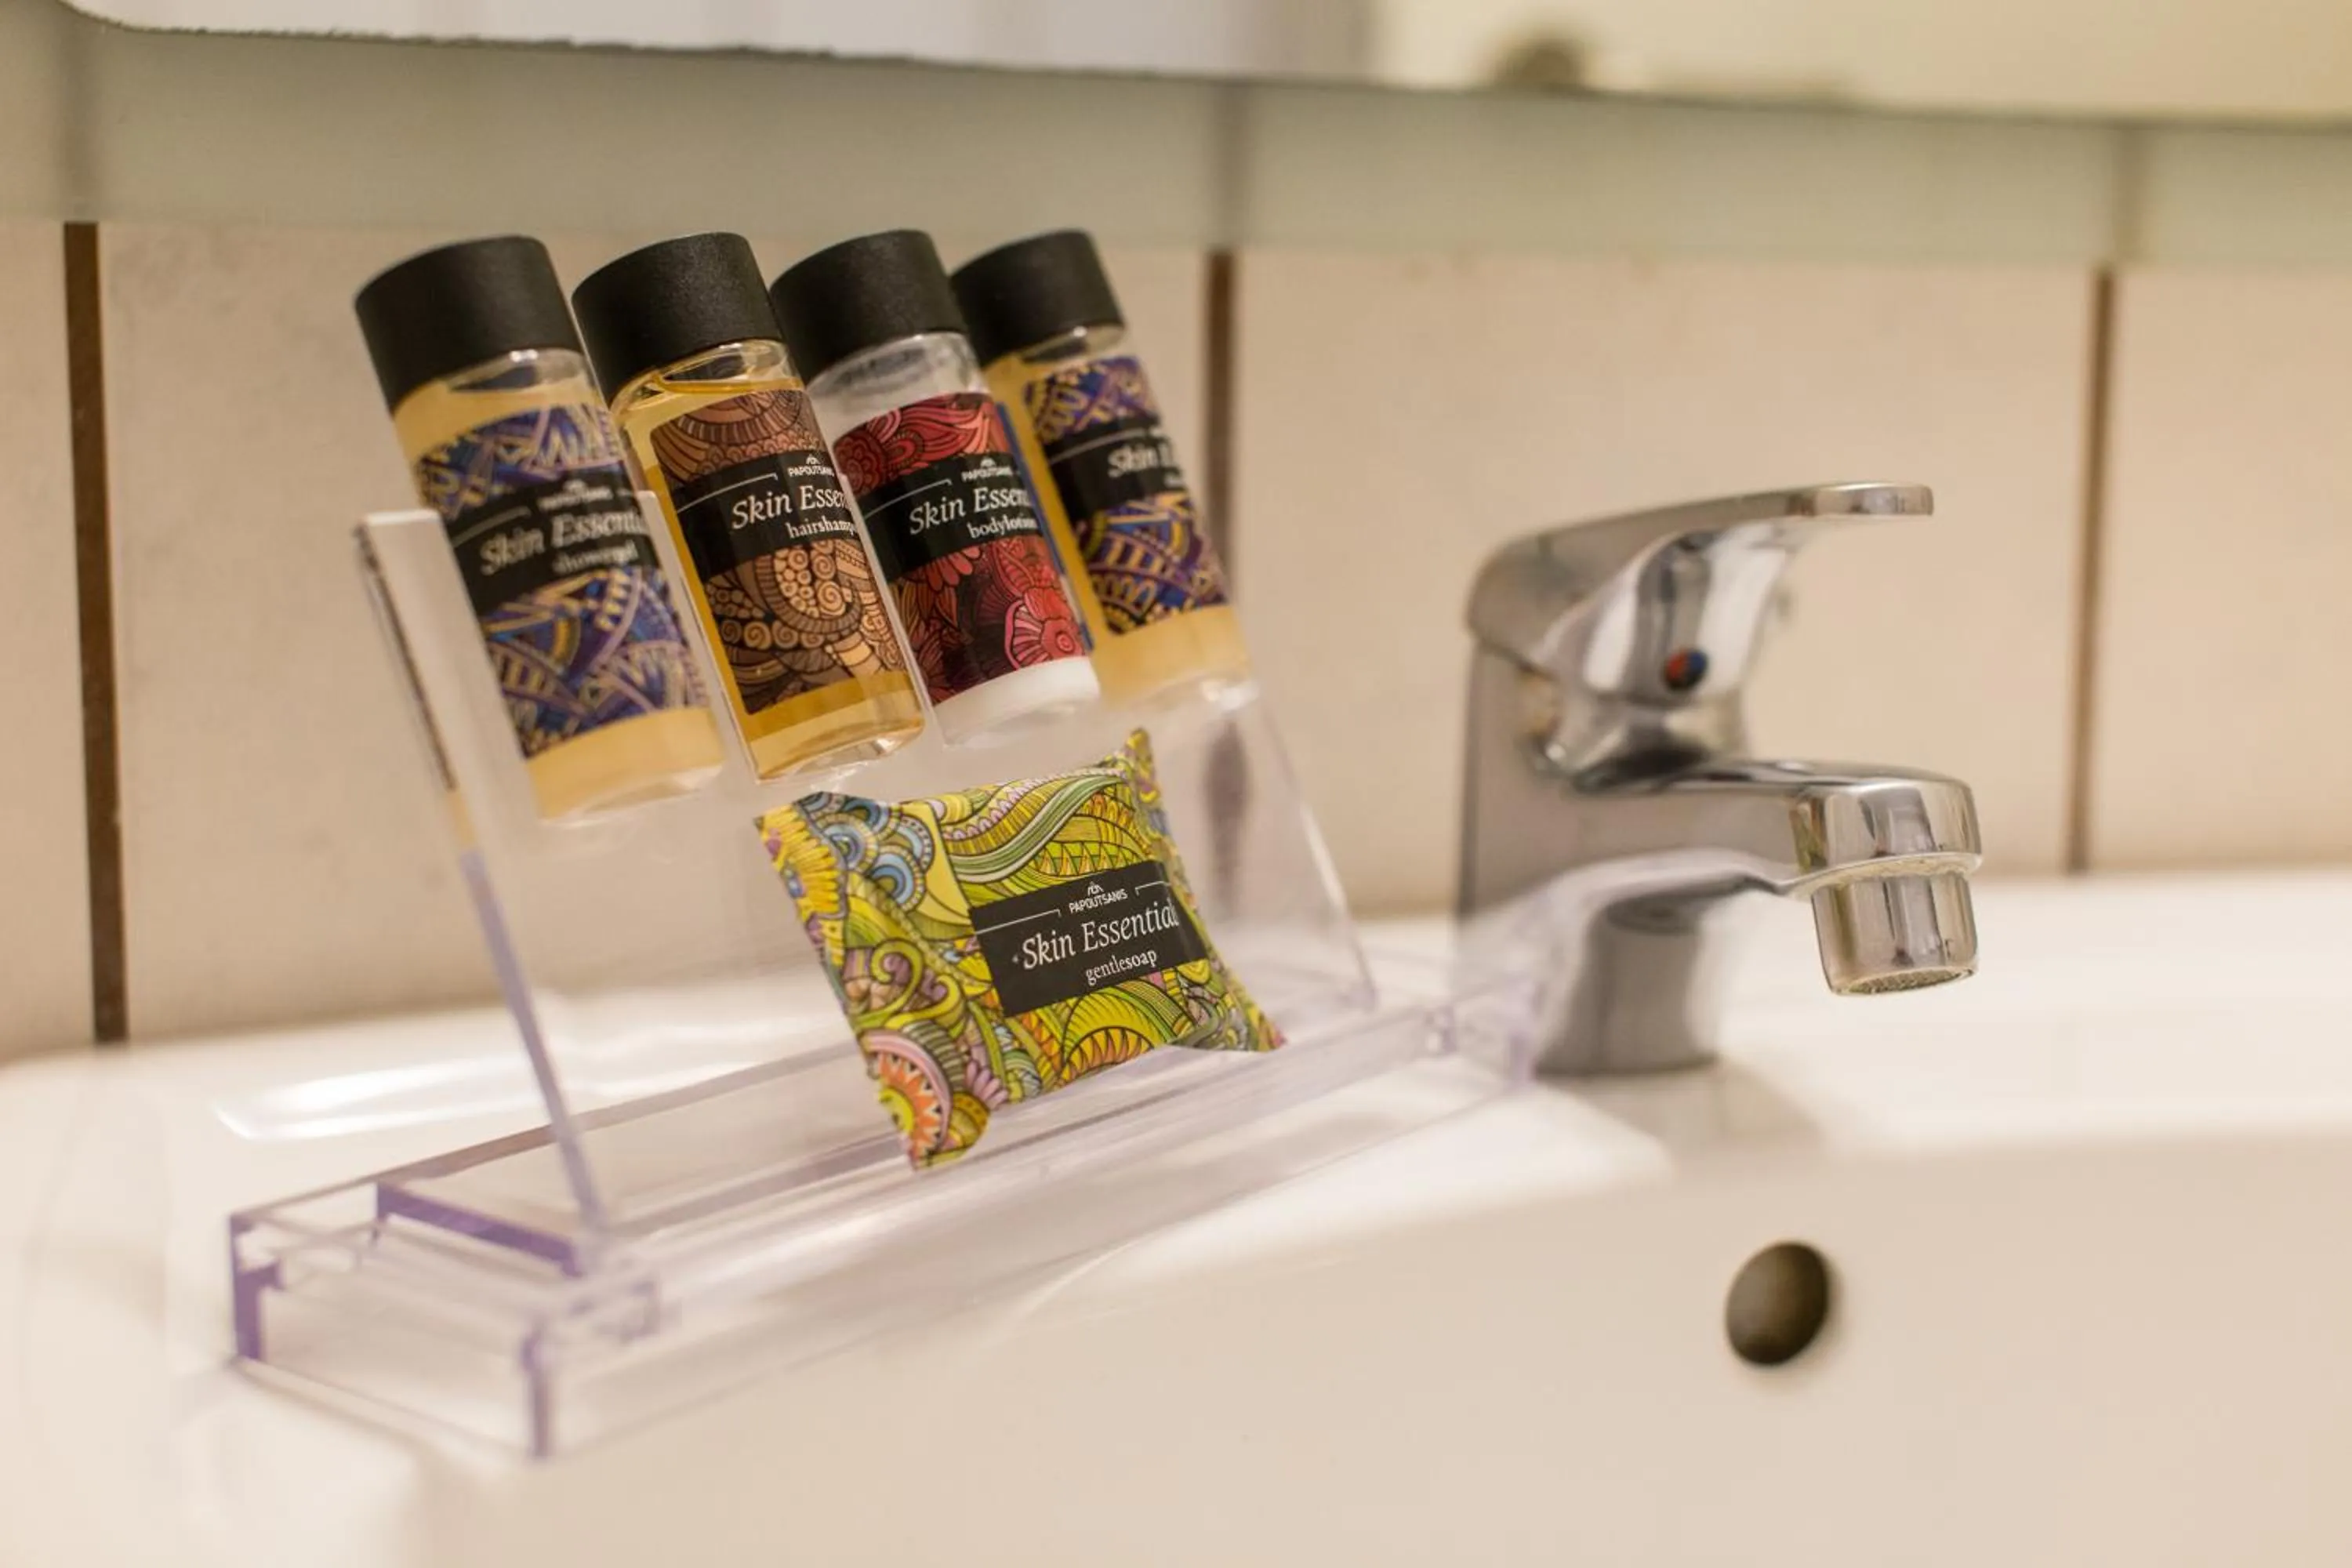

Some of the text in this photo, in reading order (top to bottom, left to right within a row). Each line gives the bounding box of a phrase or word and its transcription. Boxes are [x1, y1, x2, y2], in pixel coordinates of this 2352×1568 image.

[732, 492, 793, 529] Skin
[909, 496, 966, 535] Skin
[480, 528, 546, 575] Skin
[1069, 888, 1129, 914] PAPOUTSANIS
[1022, 931, 1076, 970] Skin
[1085, 949, 1158, 986] gentlesoap
